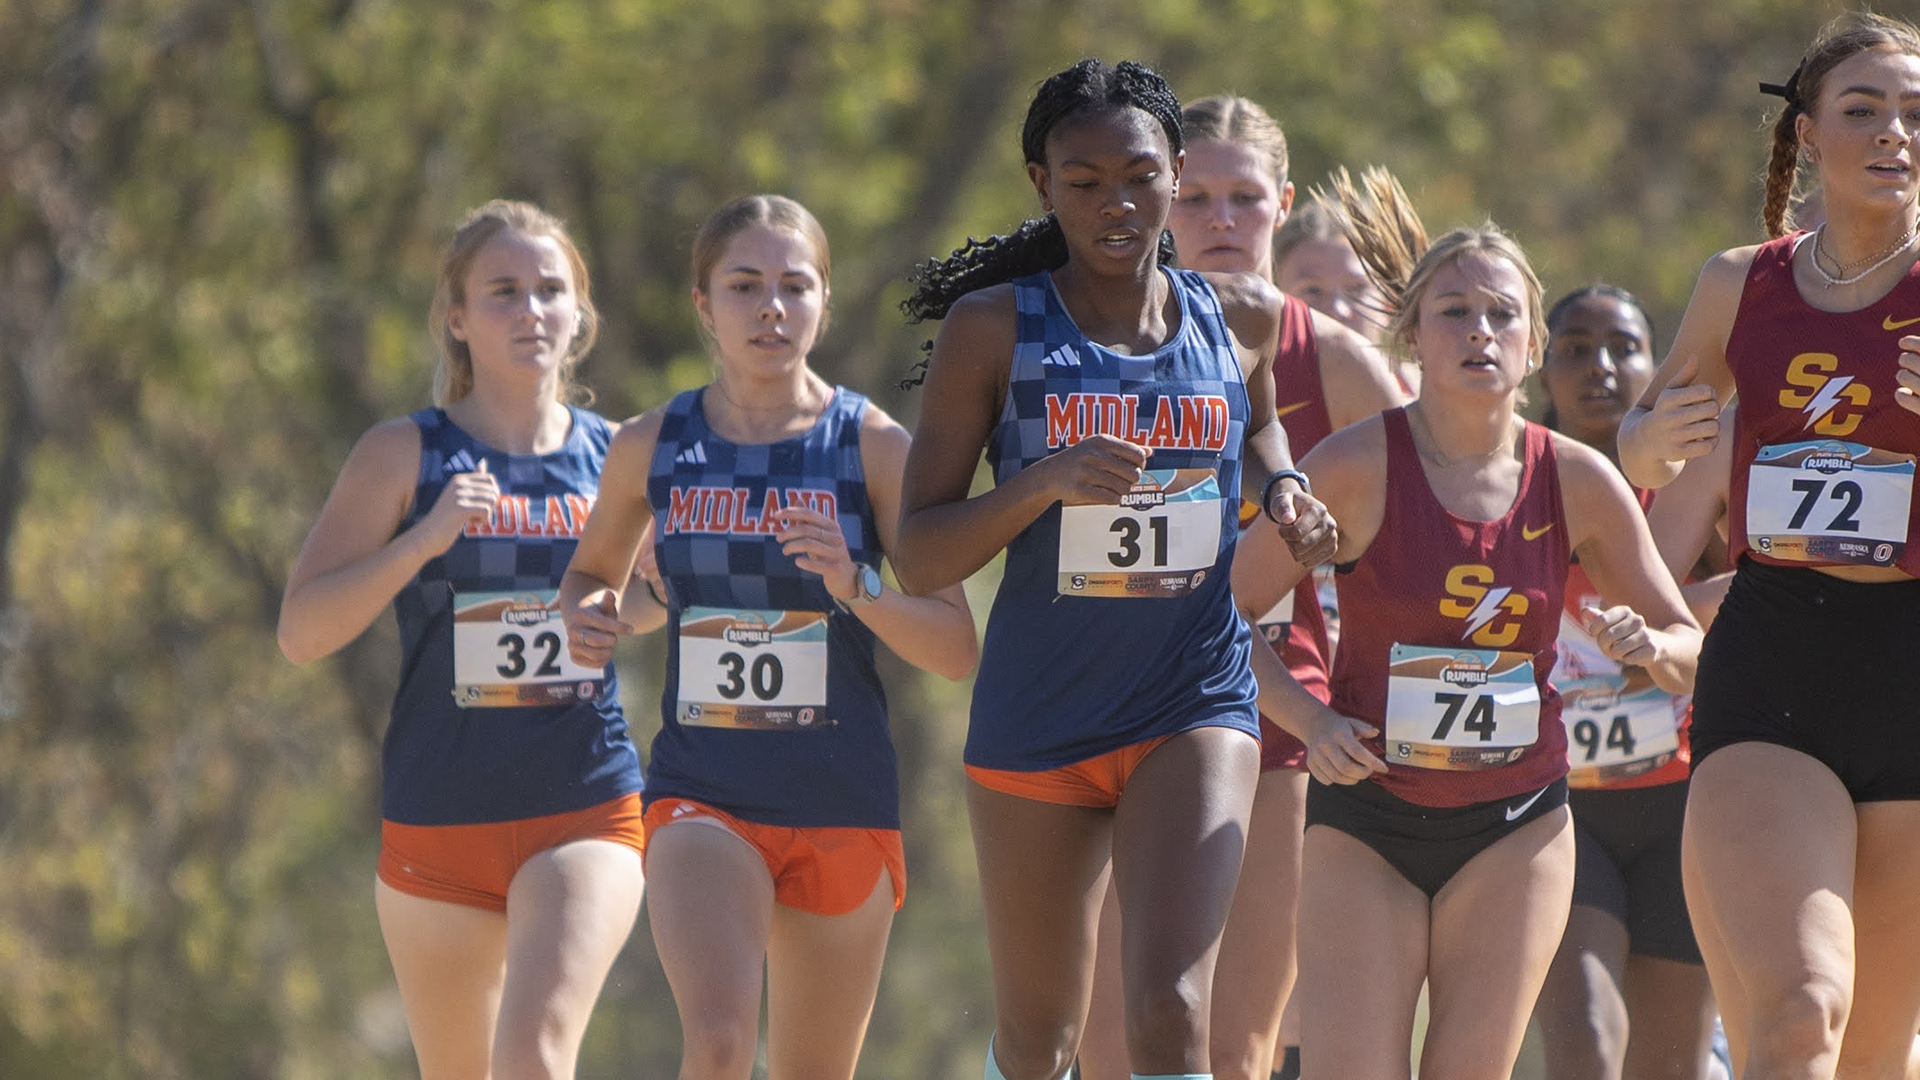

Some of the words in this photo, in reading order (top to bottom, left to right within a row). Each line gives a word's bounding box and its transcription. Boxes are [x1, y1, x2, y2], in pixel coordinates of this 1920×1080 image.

[1045, 393, 1230, 451] MIDLAND
[1807, 458, 1852, 469] RUMBLE
[1121, 492, 1164, 506] RUMBLE
[1787, 479, 1863, 532] 72
[1107, 516, 1168, 568] 31
[496, 631, 561, 679] 32
[716, 652, 784, 701] 30
[1446, 670, 1487, 683] RUMBLE
[1431, 692, 1497, 742] 74
[1573, 715, 1638, 761] 94
